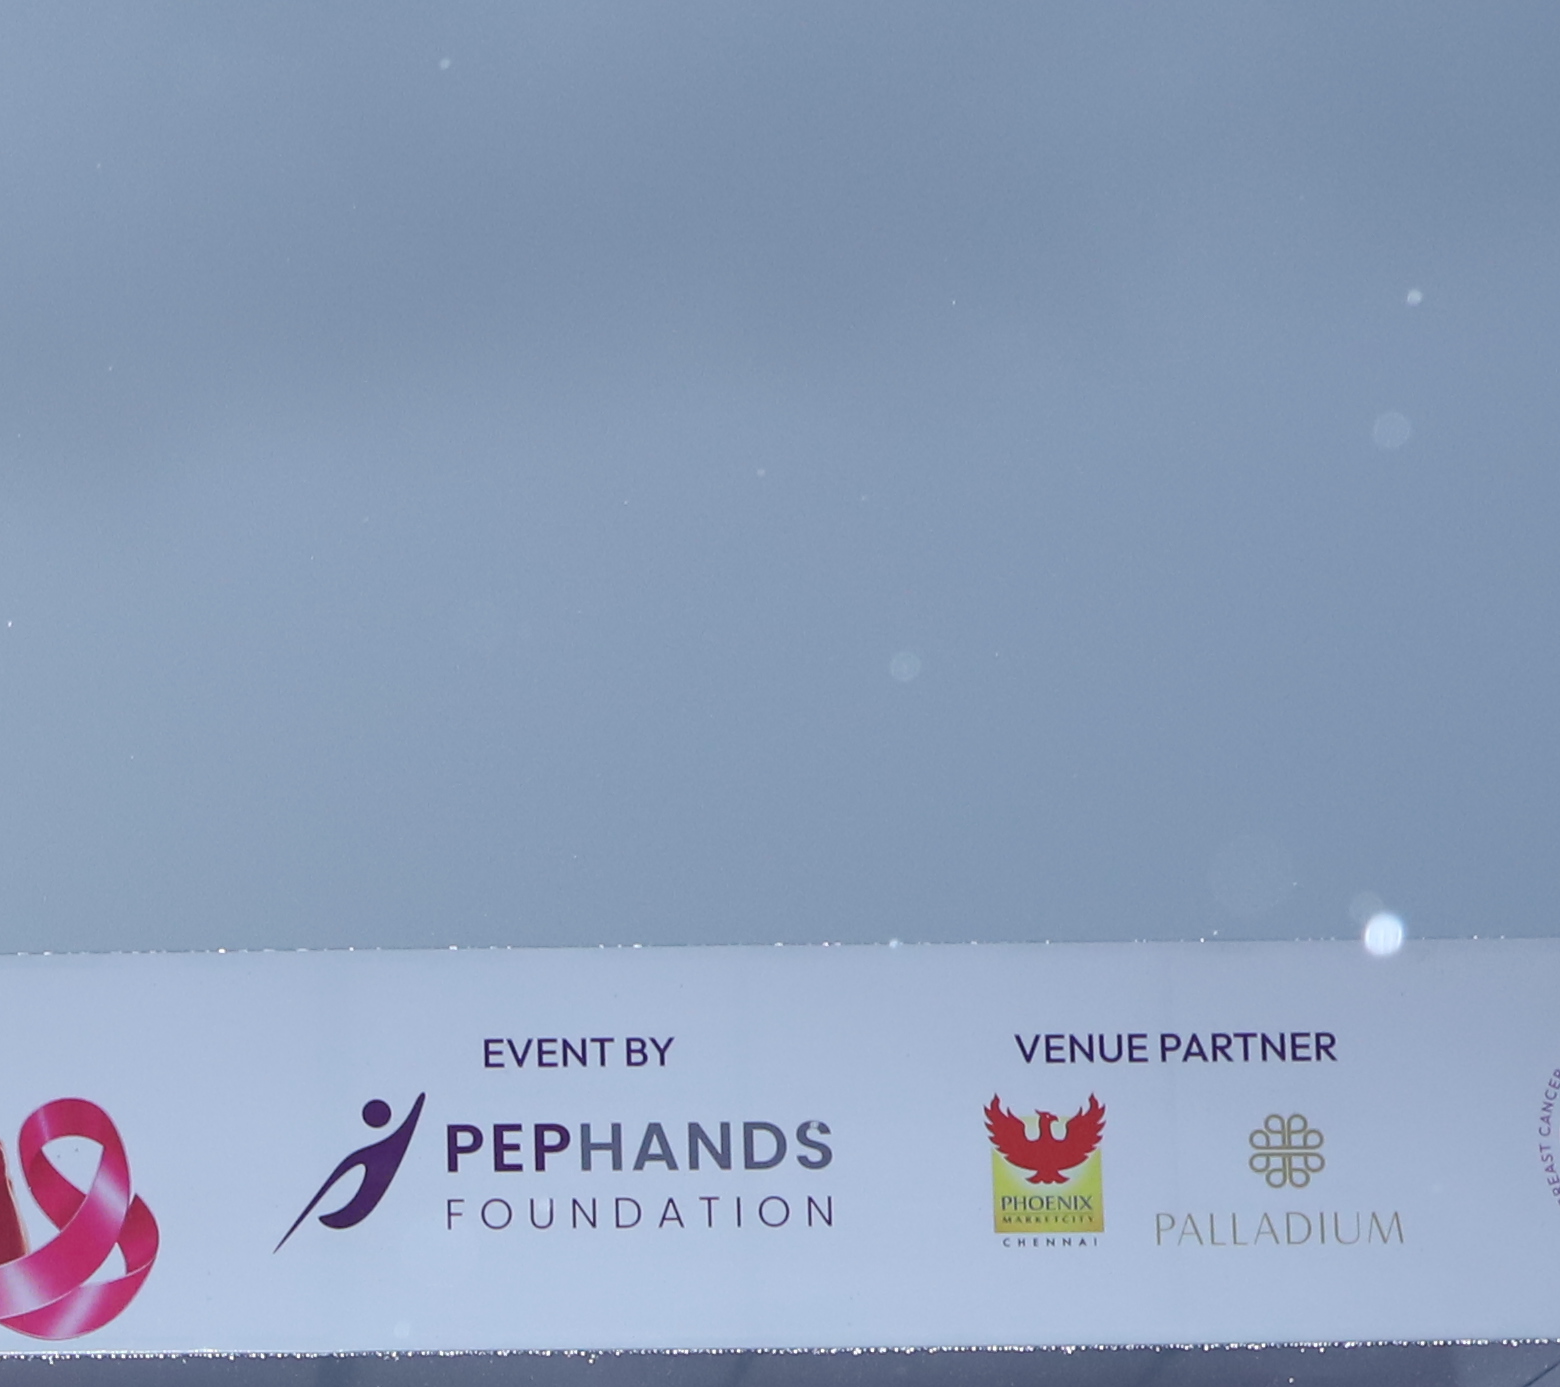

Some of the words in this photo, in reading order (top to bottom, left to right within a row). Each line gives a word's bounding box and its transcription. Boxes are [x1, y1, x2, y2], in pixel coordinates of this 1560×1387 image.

[483, 1037, 614, 1067] EVENT
[625, 1037, 674, 1066] BY
[1014, 1034, 1148, 1063] VENUE
[1160, 1032, 1337, 1062] PARTNER
[447, 1122, 833, 1172] PEPHANDS
[447, 1195, 834, 1230] FOUNDATION
[1001, 1195, 1092, 1211] PHOENIX
[1003, 1215, 1095, 1225] MARKETCITY
[1156, 1211, 1404, 1246] PALLADIUM
[1003, 1237, 1098, 1248] CHENNAI
